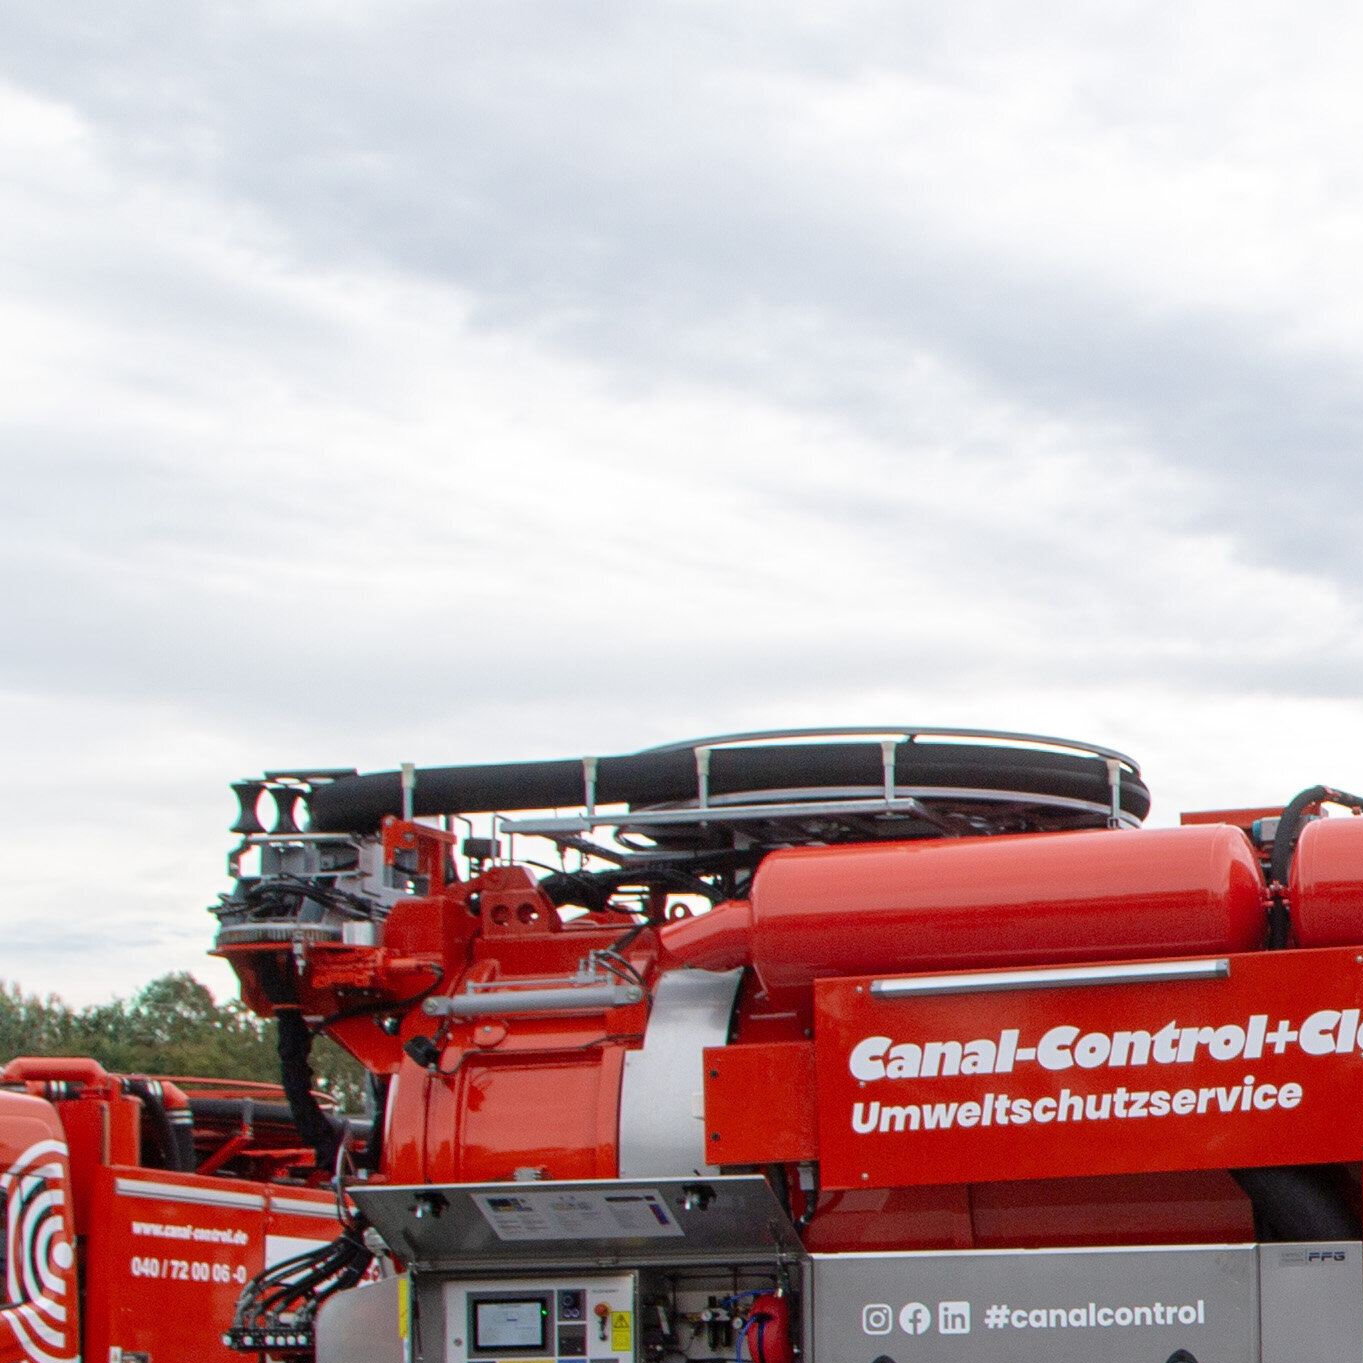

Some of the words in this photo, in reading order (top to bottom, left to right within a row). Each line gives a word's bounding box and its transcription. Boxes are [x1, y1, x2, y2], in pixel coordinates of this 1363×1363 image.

[851, 1075, 1303, 1135] Umweltschutzservice
[131, 1256, 160, 1278] 040
[170, 1259, 189, 1280] 72
[191, 1261, 210, 1281] 00
[212, 1263, 230, 1283] 06
[984, 1300, 1205, 1329] #canalcontrol
